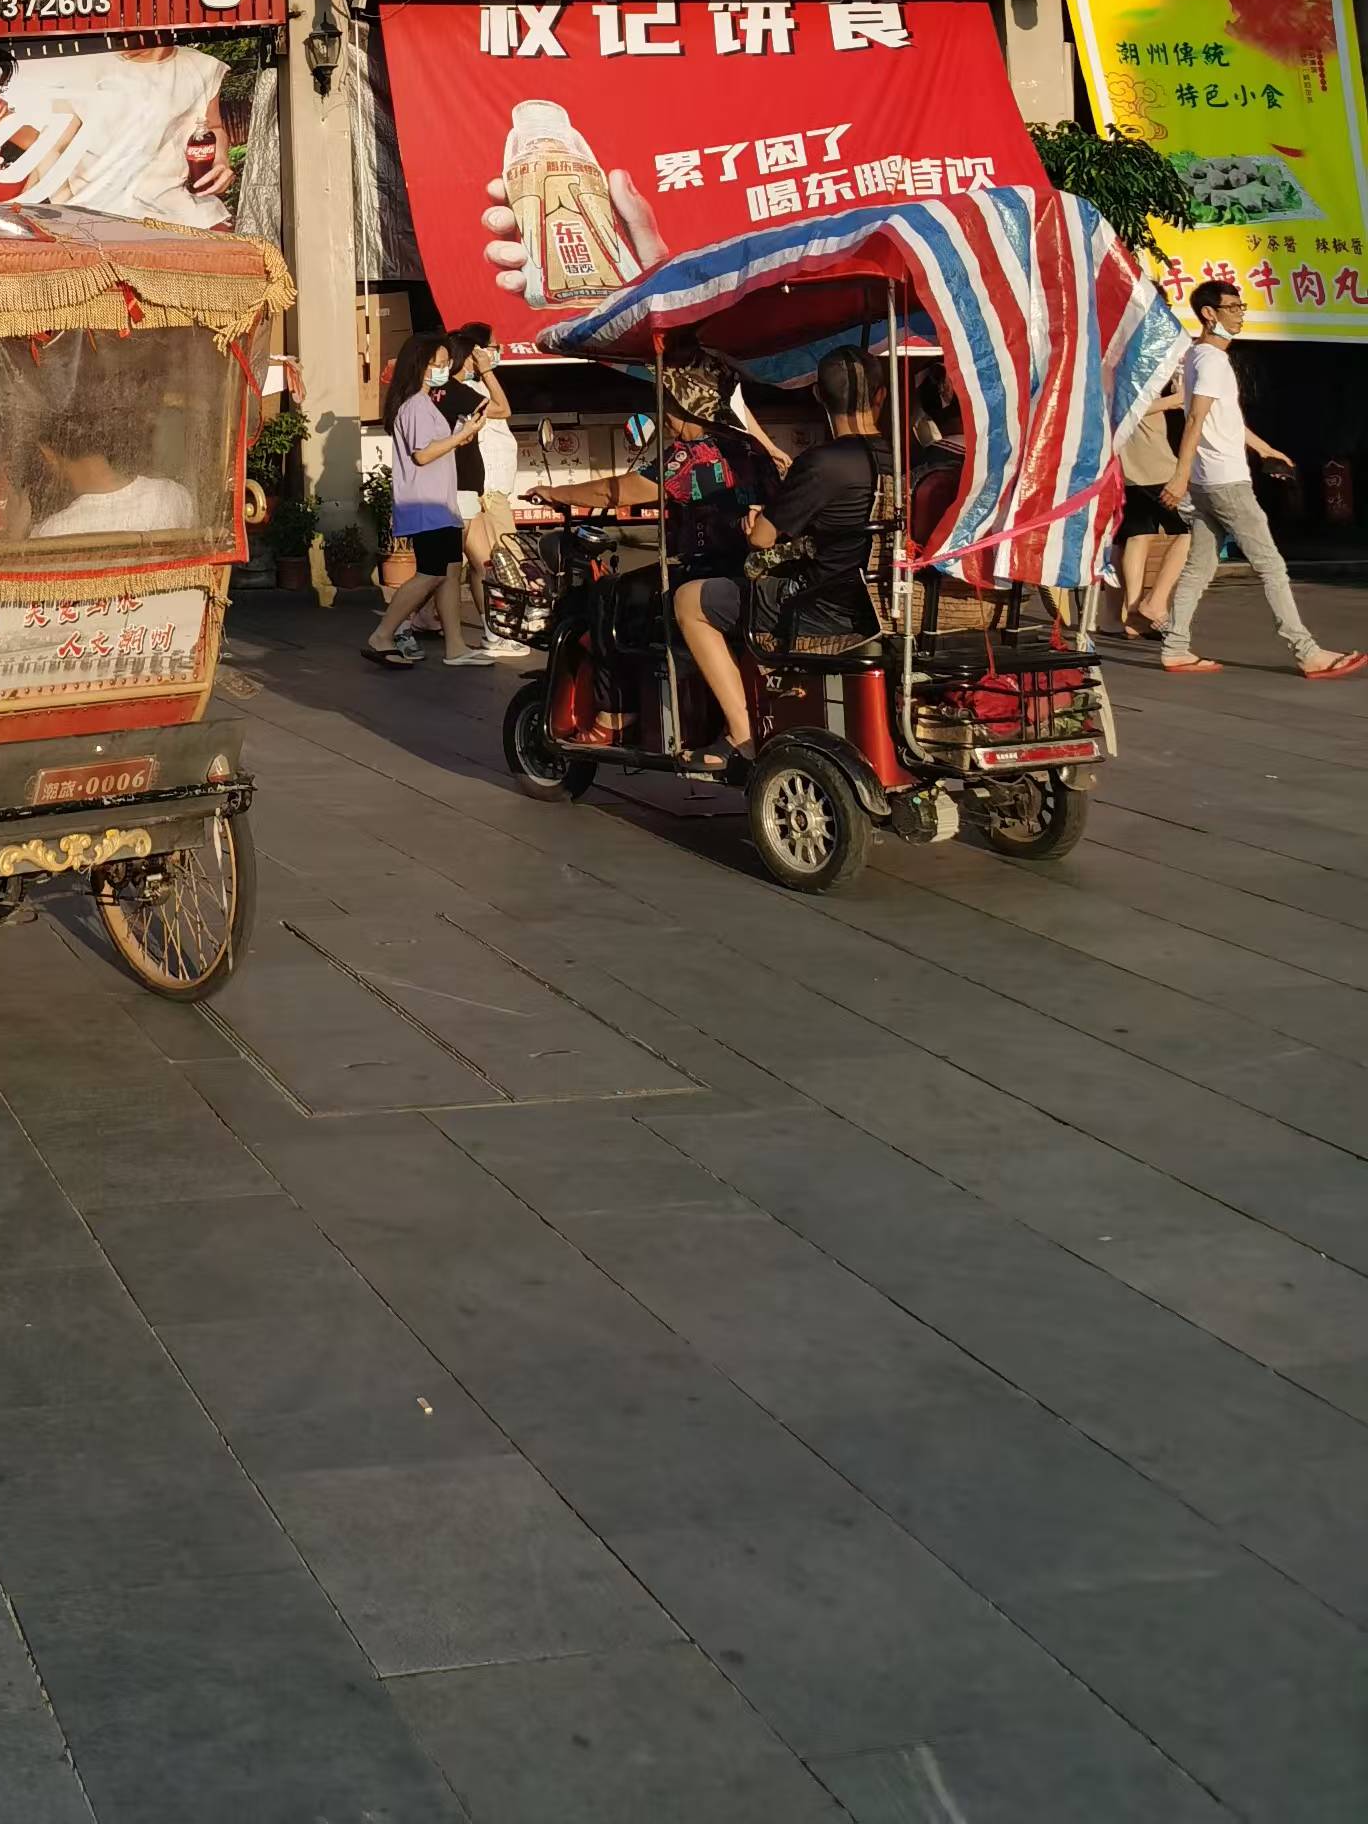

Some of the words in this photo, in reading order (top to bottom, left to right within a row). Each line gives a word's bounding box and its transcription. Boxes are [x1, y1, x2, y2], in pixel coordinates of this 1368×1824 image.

[1116, 41, 1231, 68] 潮州傳統
[1175, 83, 1283, 110] 特色小食
[654, 123, 852, 193] 累了困了
[745, 154, 996, 223] 喝东鹏特饮
[57, 623, 175, 659] 人文潮州
